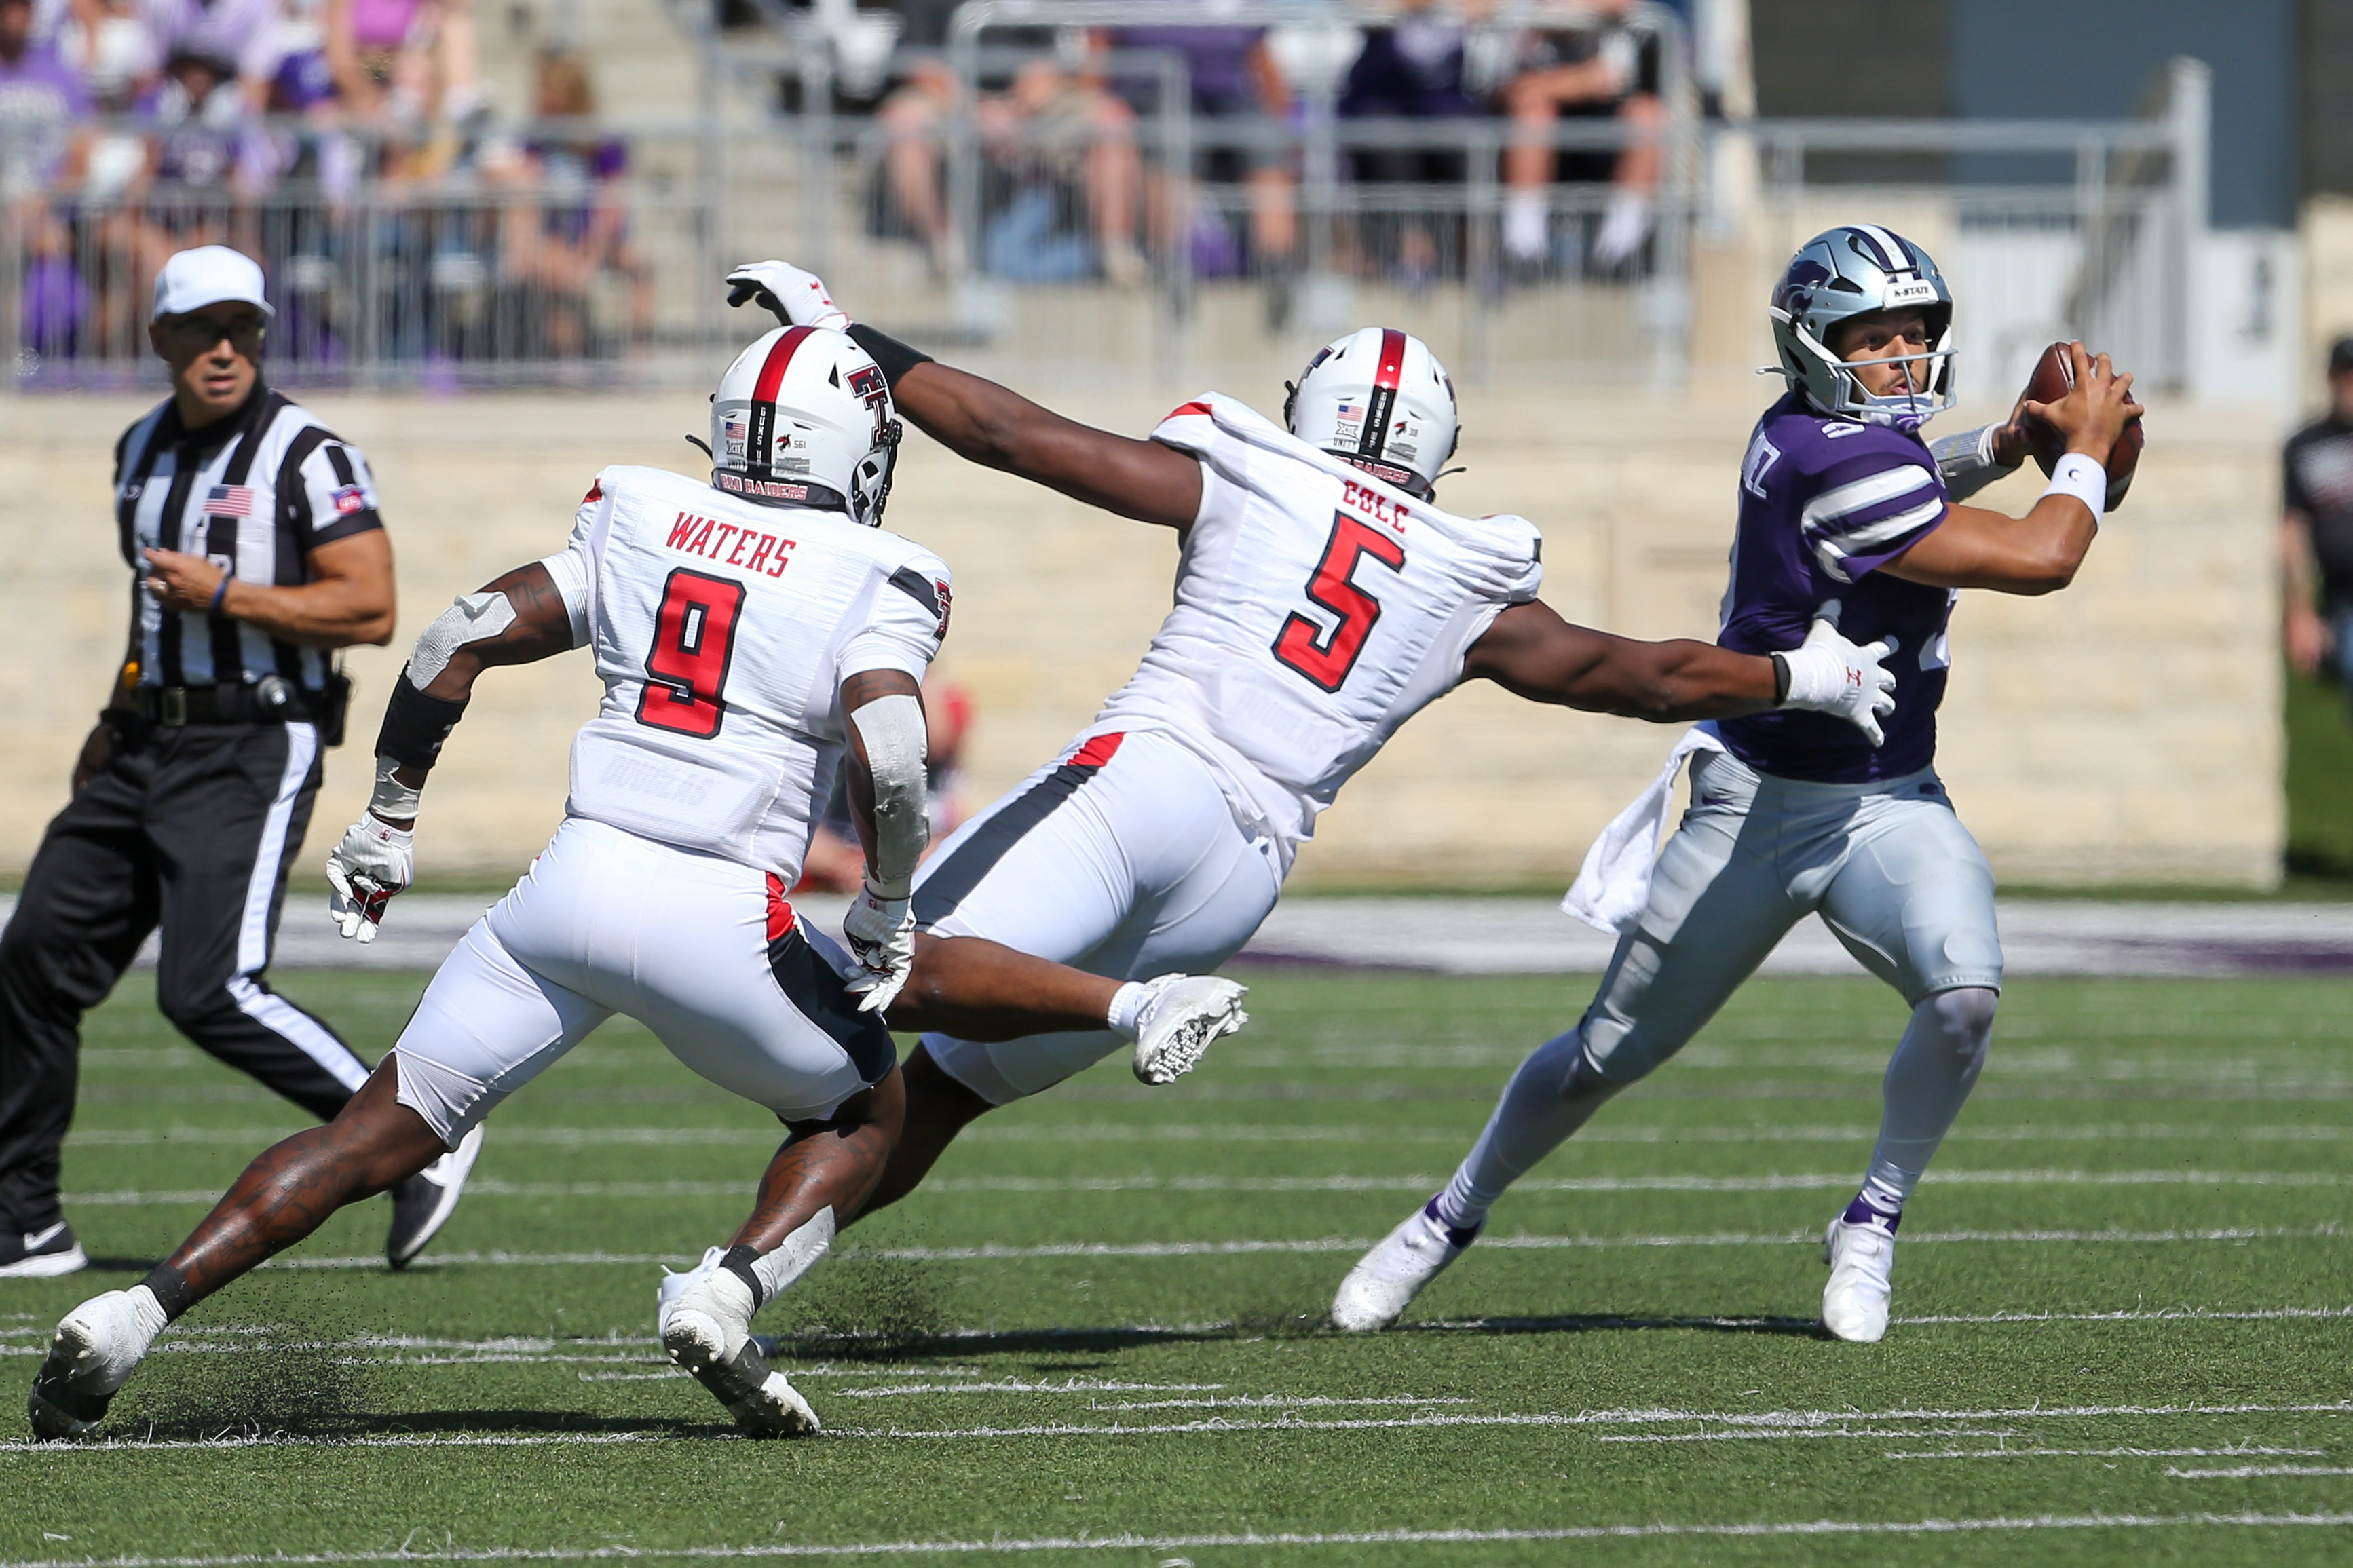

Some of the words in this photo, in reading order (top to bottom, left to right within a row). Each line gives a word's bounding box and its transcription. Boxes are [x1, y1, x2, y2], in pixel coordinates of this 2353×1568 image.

[757, 407, 766, 446] GUNS
[720, 474, 743, 492] RED
[745, 478, 808, 501] RAIDERS
[1343, 479, 1409, 534] COLE
[666, 512, 796, 578] WATERS
[1271, 508, 1406, 694] 5
[634, 565, 747, 740] 9
